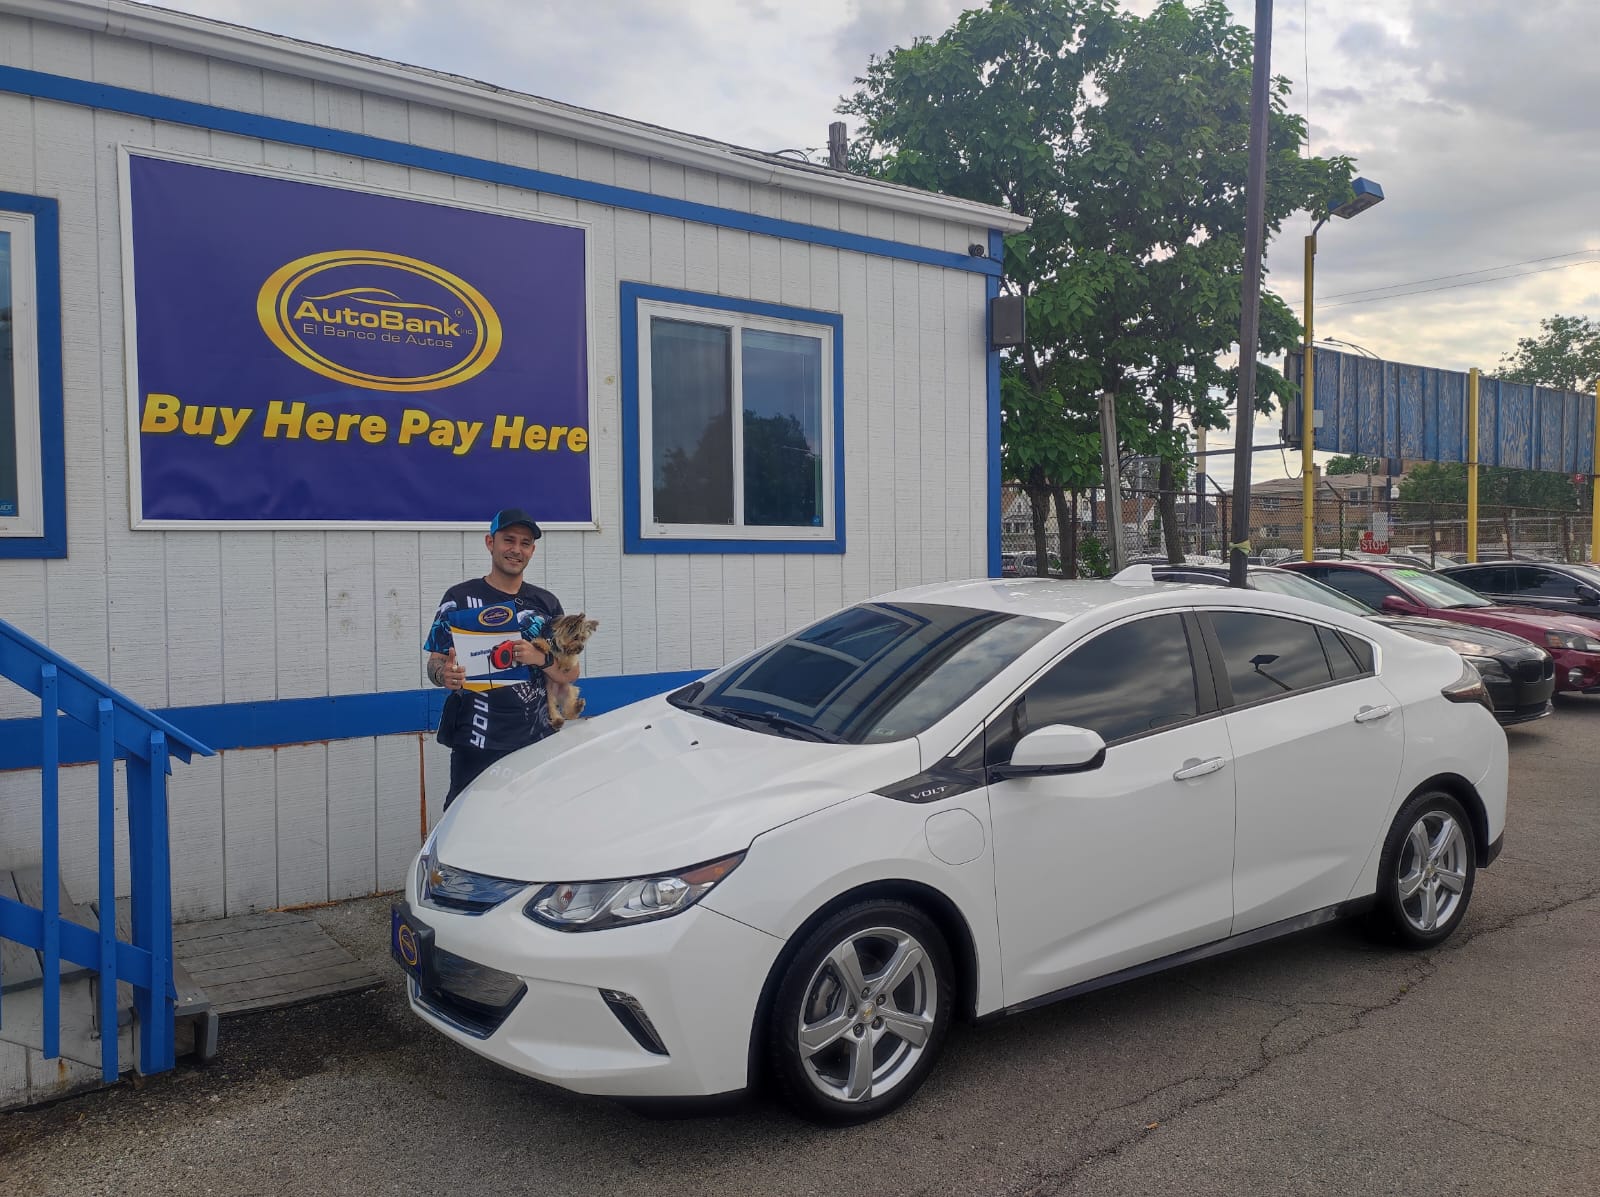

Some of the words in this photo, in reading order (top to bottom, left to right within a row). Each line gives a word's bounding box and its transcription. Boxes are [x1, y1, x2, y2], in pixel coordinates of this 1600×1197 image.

[294, 300, 460, 337] AutoBank
[303, 323, 318, 335] El
[323, 325, 377, 341] Banco
[381, 331, 401, 343] de
[405, 334, 453, 348] Autos
[140, 393, 253, 446] Buy
[263, 400, 387, 443] Here
[398, 409, 483, 455] Pay
[491, 415, 589, 452] Here
[1361, 539, 1386, 551] STOP
[910, 785, 949, 799] VOLT
